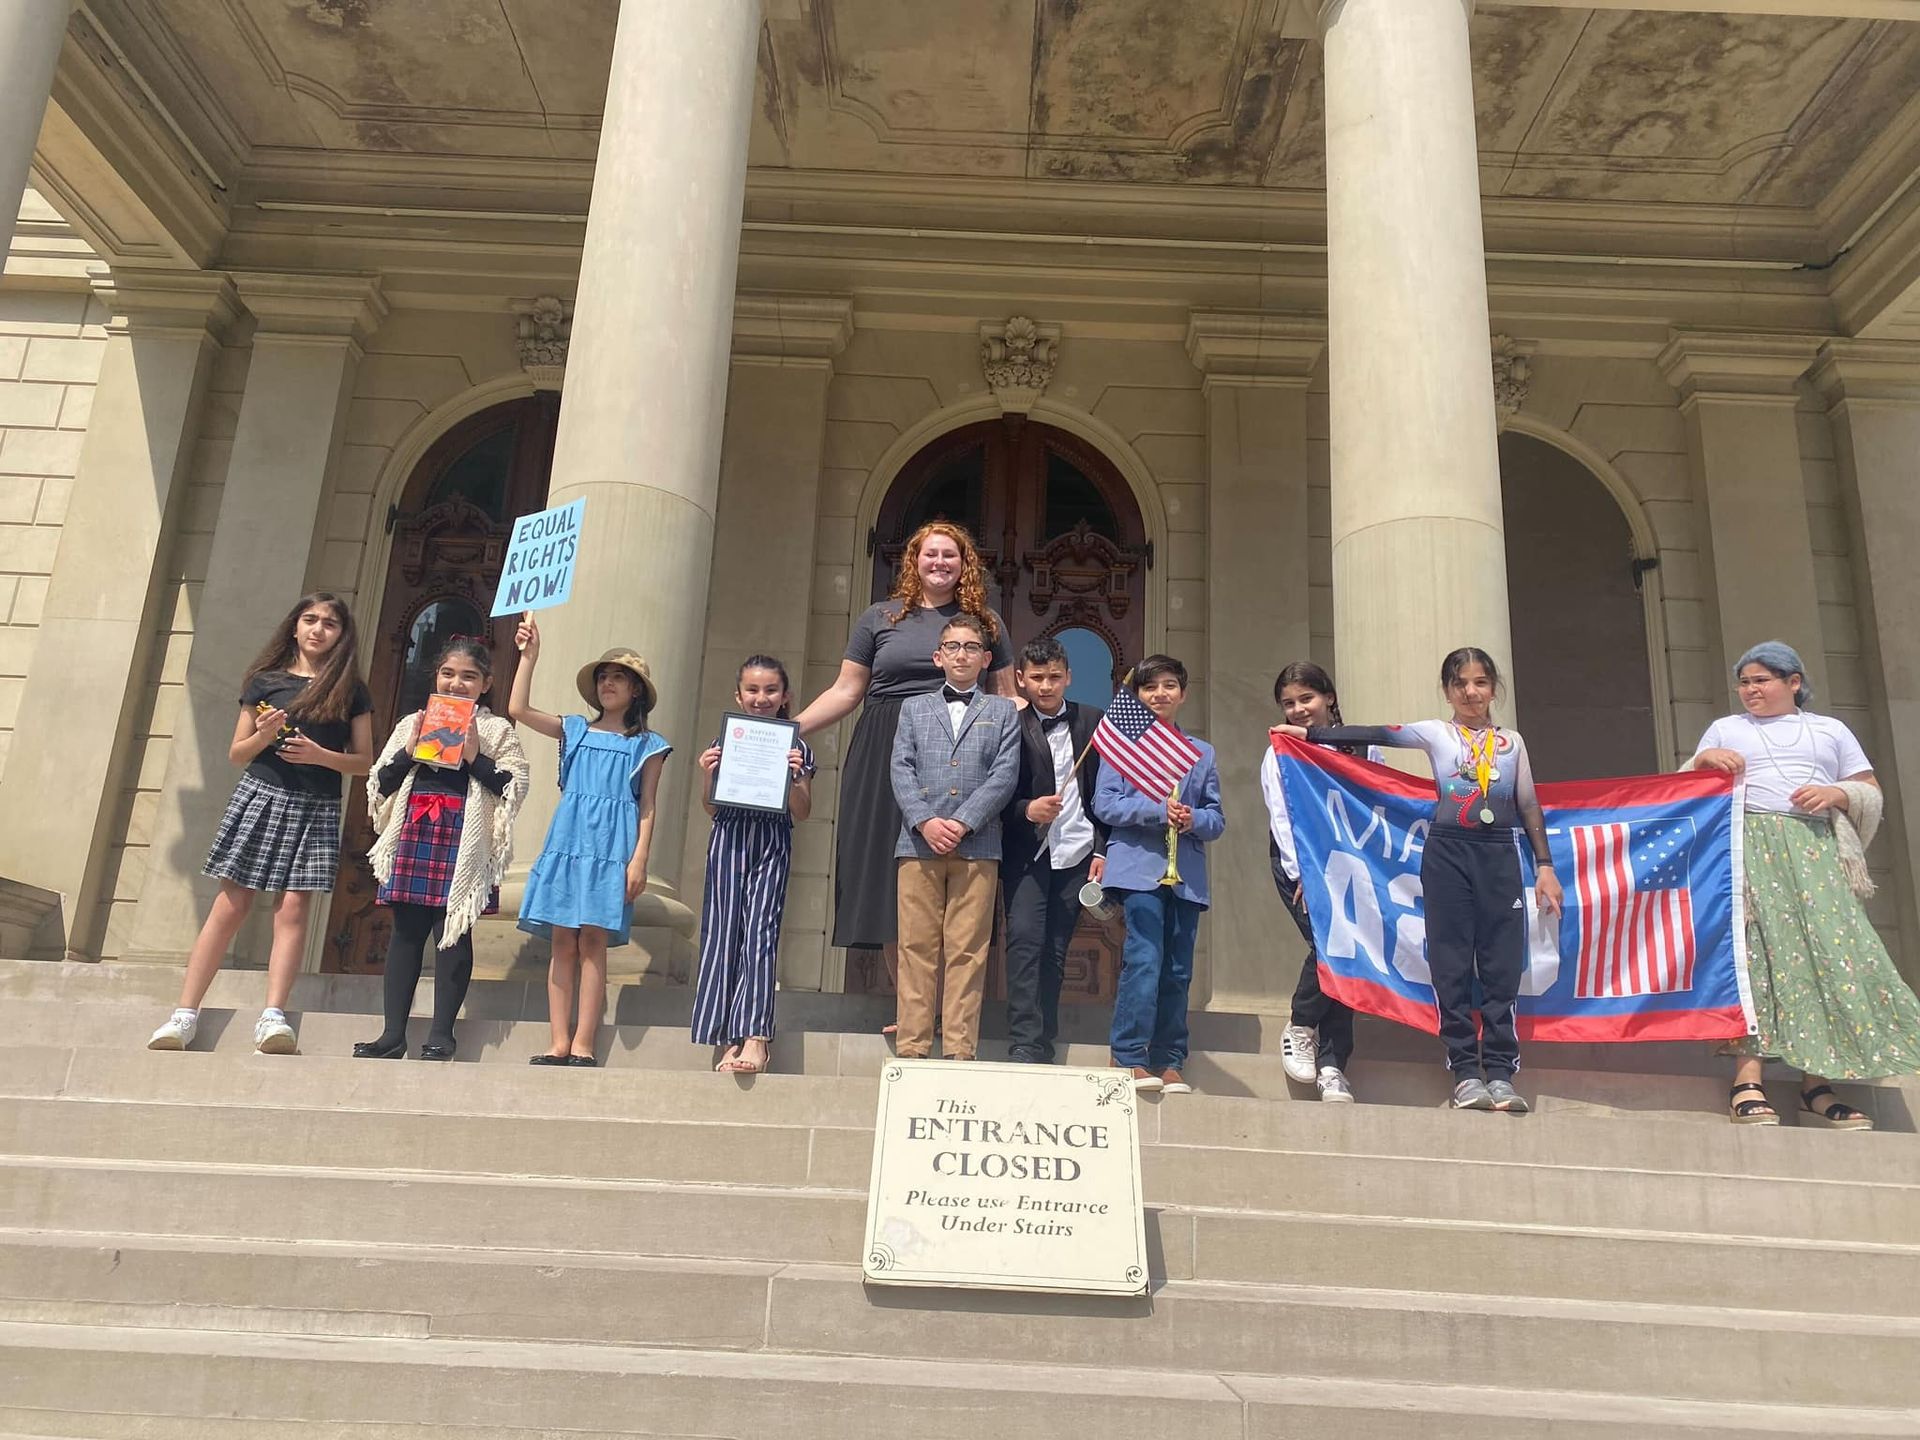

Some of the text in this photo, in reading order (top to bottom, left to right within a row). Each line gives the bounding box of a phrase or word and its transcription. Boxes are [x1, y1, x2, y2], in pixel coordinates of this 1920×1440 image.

[518, 506, 576, 544] EQUAL
[507, 534, 577, 576] RIGHTS
[505, 566, 568, 607] NOW!
[936, 1098, 977, 1115] This
[907, 1117, 1109, 1149] ENTRANCE
[932, 1151, 1081, 1181] CLOSED
[905, 1190, 970, 1208] Please
[941, 1215, 1073, 1237] Under Stairs
